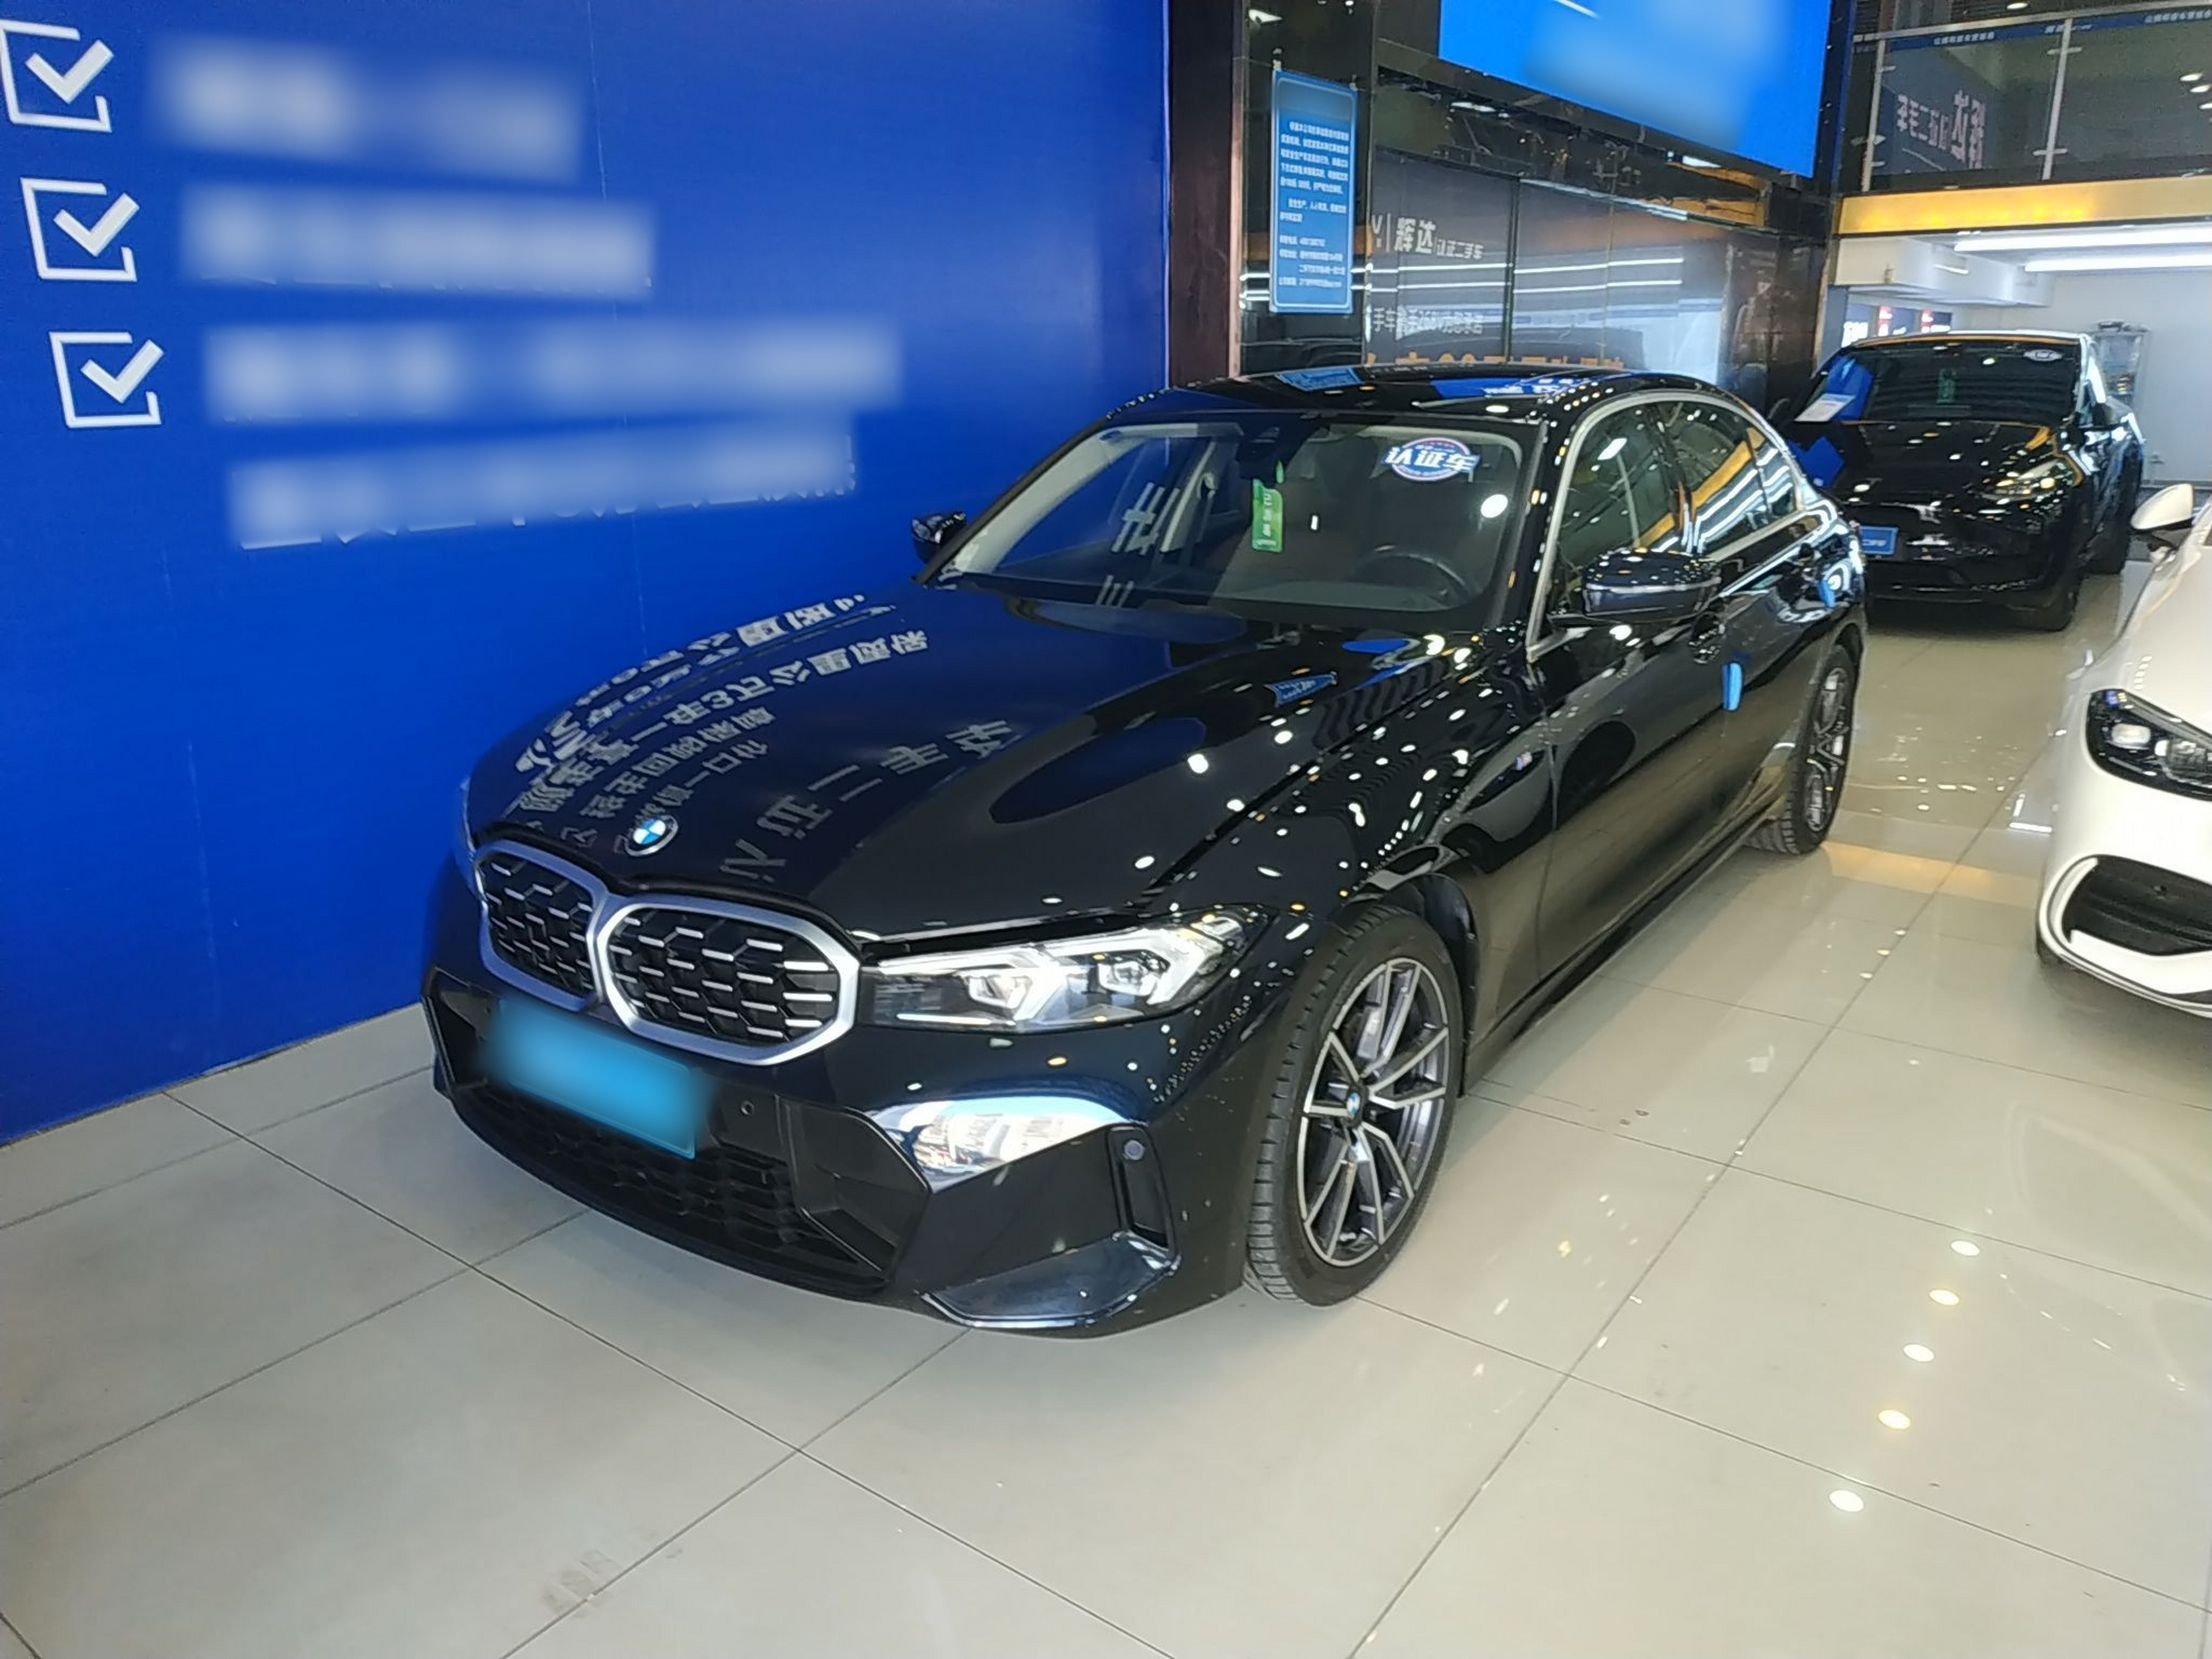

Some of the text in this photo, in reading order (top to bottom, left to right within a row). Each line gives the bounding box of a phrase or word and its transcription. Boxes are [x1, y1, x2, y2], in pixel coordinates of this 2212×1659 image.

[1394, 217, 1437, 254] 辉达
[1385, 446, 1480, 474] 认证车
